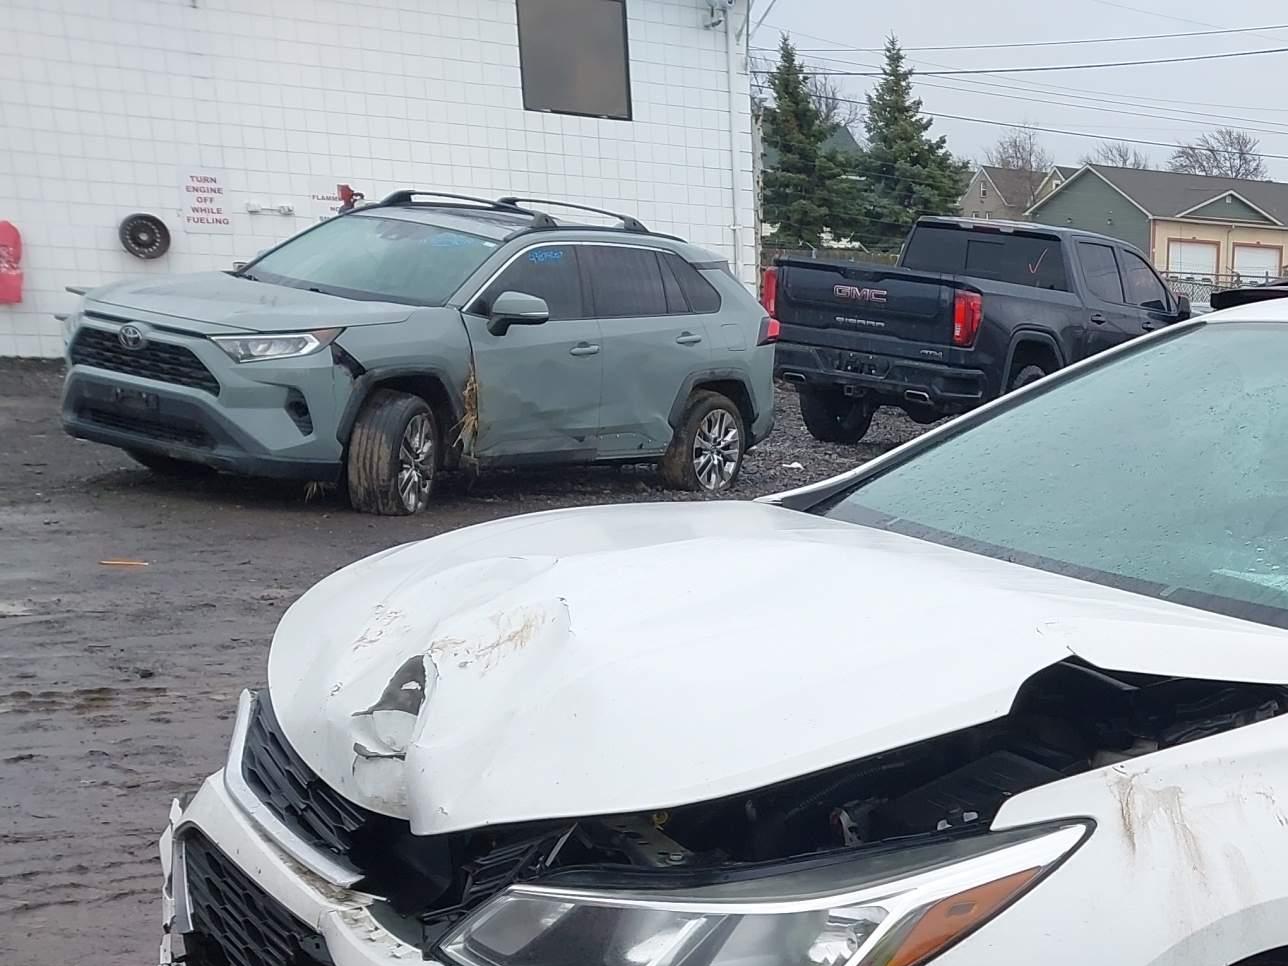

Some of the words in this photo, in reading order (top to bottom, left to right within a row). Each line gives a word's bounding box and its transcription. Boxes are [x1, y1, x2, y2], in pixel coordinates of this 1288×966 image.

[190, 175, 217, 184] TURN
[185, 185, 224, 194] ENGINE
[196, 196, 214, 204] OFF
[190, 206, 223, 215] WHILE
[186, 216, 230, 225] FUELING
[833, 284, 887, 302] GMC
[835, 315, 886, 328] SIERRA
